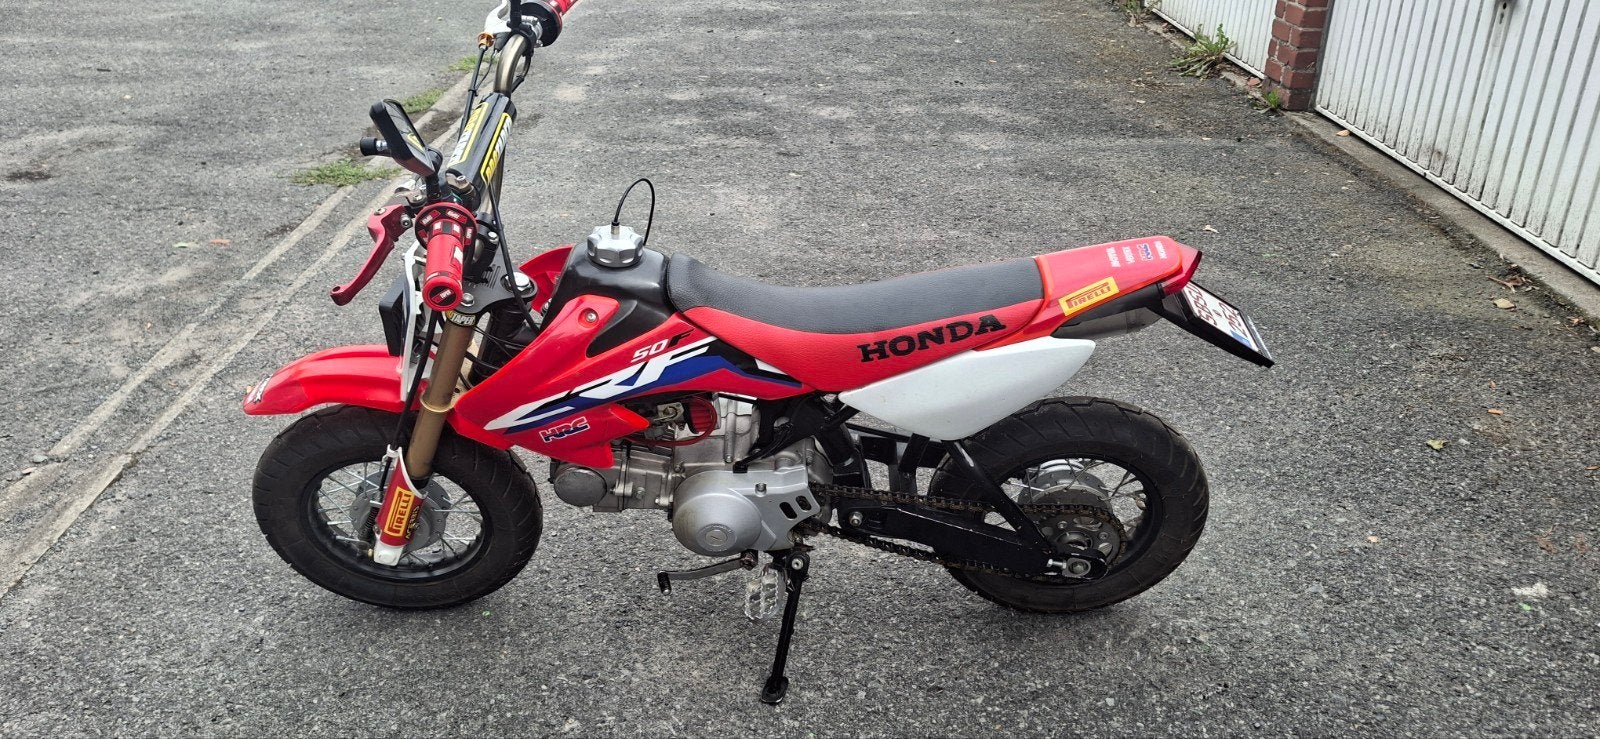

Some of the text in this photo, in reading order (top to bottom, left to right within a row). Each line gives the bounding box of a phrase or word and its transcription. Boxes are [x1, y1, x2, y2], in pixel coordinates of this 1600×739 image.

[1066, 281, 1111, 310] PIRELLI
[631, 328, 695, 363] 50F
[857, 313, 1007, 363] HONDA
[483, 335, 718, 430] CRF
[539, 416, 590, 443] HRC
[387, 491, 412, 534] PIRELLI
